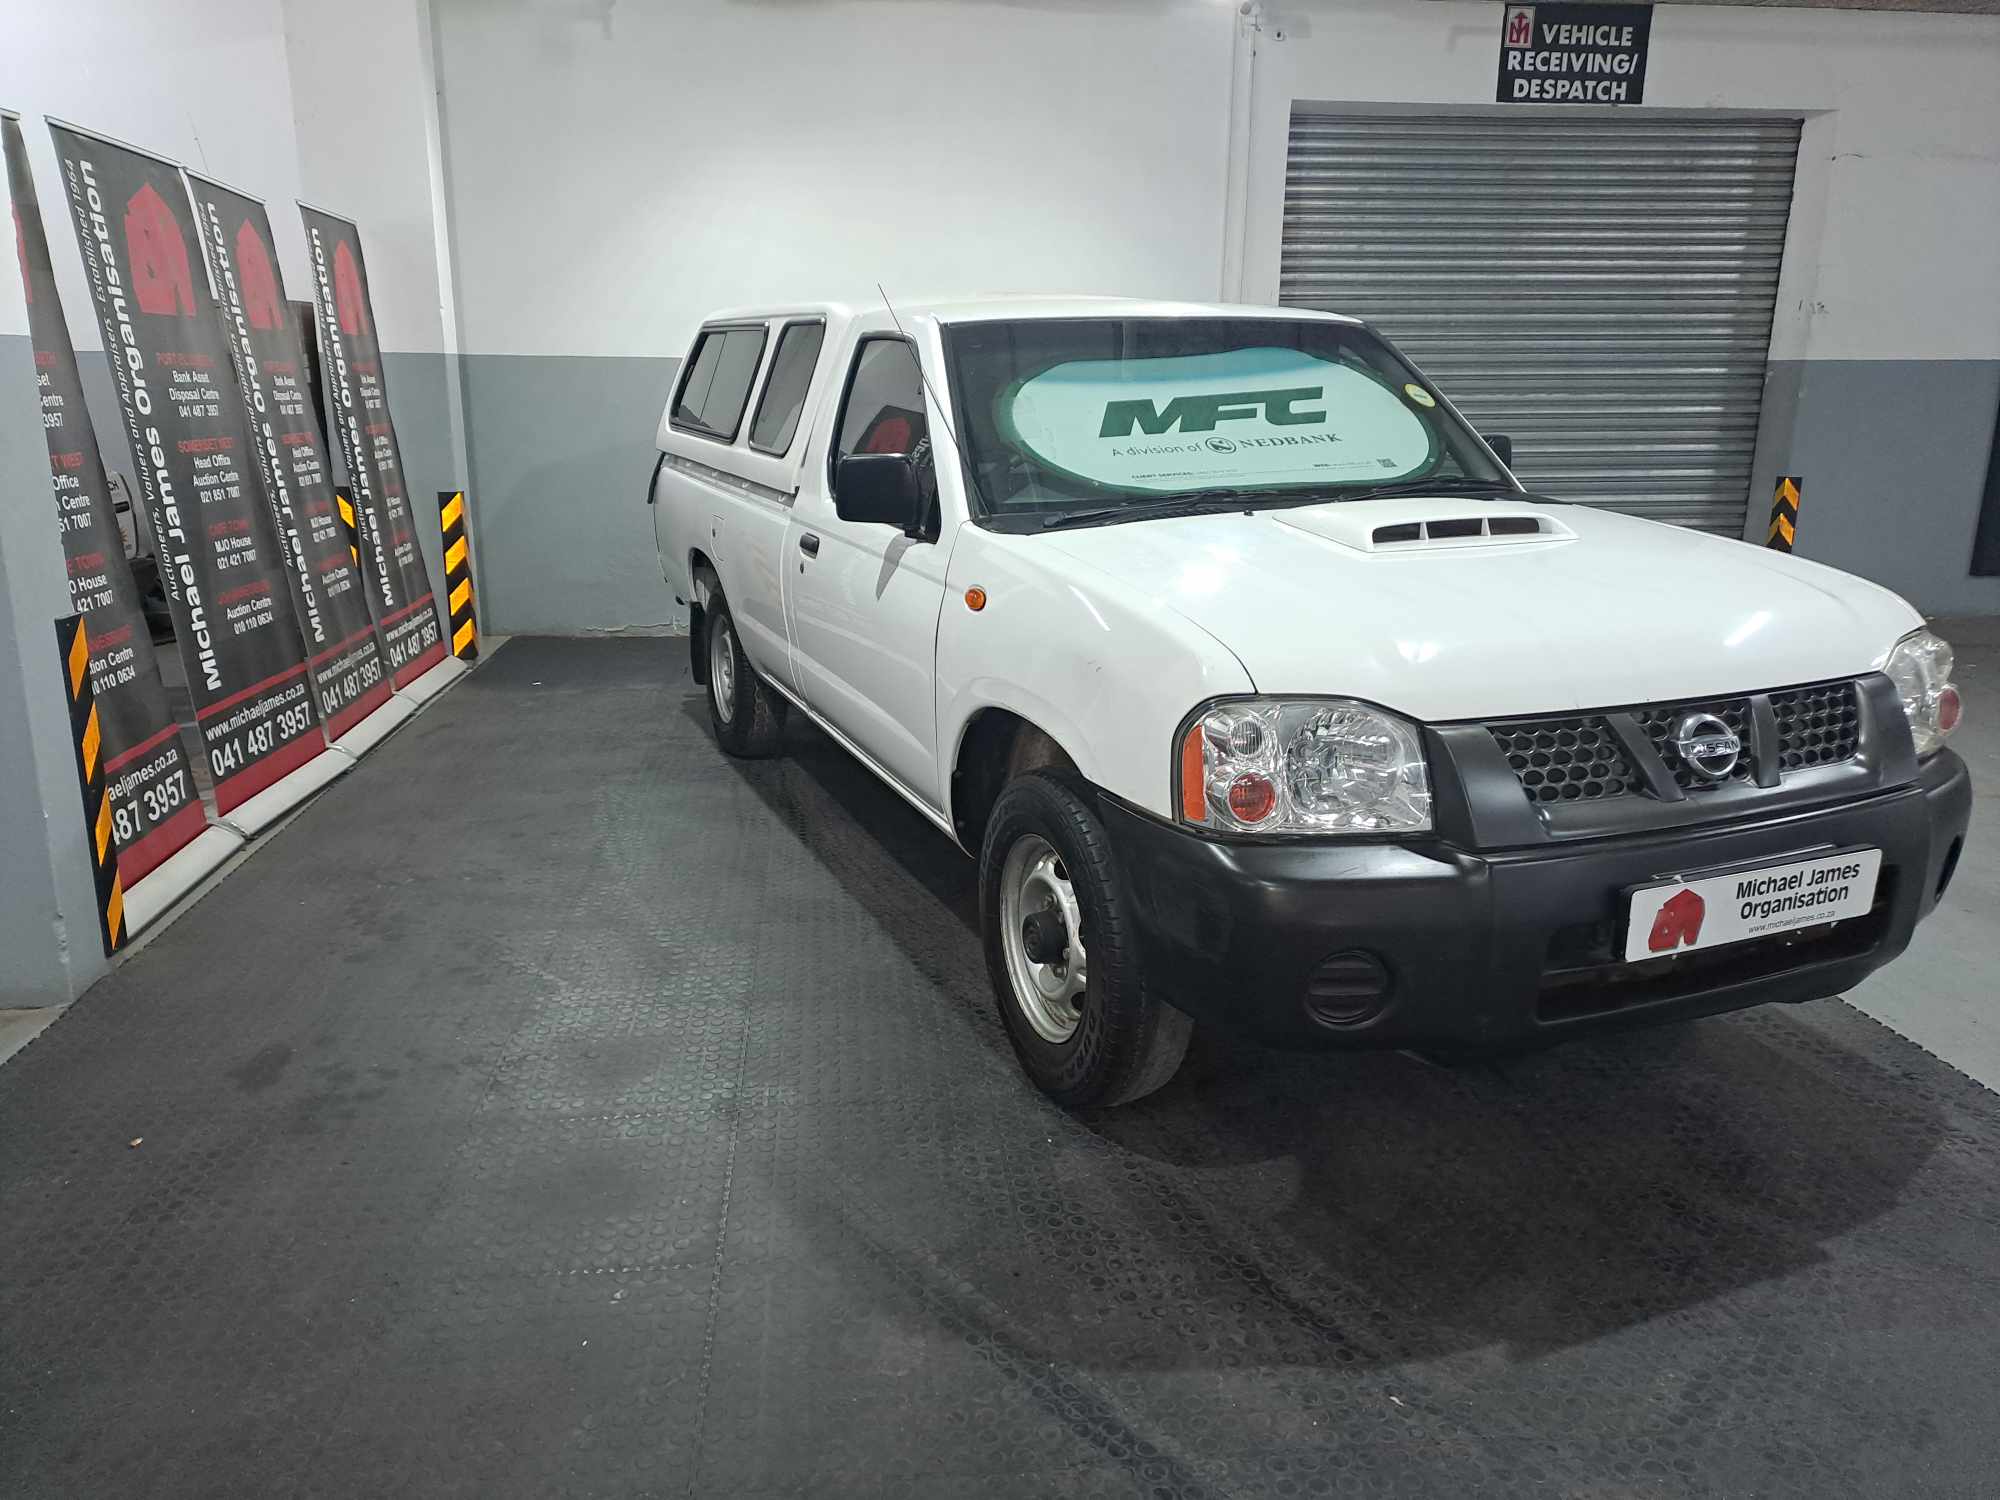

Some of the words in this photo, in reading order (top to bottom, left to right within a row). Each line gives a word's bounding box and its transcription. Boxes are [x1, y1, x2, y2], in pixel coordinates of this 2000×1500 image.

[1542, 24, 1633, 46] VEHICLE
[1507, 51, 1639, 75] RECEIVING/
[1513, 78, 1627, 101] DESPATCH
[64, 158, 82, 201] 1964
[74, 204, 106, 303] Established
[79, 159, 152, 416] Organisation
[207, 202, 265, 413] Organisation
[311, 228, 352, 408] Organisation
[104, 318, 132, 402] Appraisers
[172, 370, 191, 383] Bank
[40, 393, 64, 407] entre
[168, 387, 200, 402] Disposal
[42, 412, 63, 428] 3957
[125, 407, 139, 439] and
[178, 405, 192, 417] 041
[192, 404, 205, 417] 487
[247, 406, 259, 433] and
[334, 401, 345, 425] and
[1099, 386, 1327, 438] MFC
[347, 415, 372, 500] James
[1112, 447, 1124, 456] A
[1127, 443, 1184, 456] division
[1187, 442, 1202, 453] of
[1240, 433, 1342, 449] NEDBANK
[135, 443, 155, 501] Valuers
[193, 456, 211, 469] Head
[255, 436, 271, 484] Valuers
[262, 422, 294, 520] James
[52, 474, 80, 491] Office
[145, 427, 186, 544] James
[193, 473, 219, 487] Auction
[61, 494, 91, 511] Centre
[200, 490, 212, 503] 021
[212, 488, 225, 501] 851
[70, 512, 92, 530] 7007
[152, 507, 181, 600] Auctioneers,
[214, 538, 230, 553] MJO
[230, 536, 252, 549] House
[365, 507, 394, 606] Michael
[217, 556, 229, 570] 021
[229, 553, 241, 567] 421
[68, 579, 77, 594] O
[77, 574, 107, 591] House
[286, 528, 325, 643] Michael
[77, 596, 94, 612] 421
[94, 589, 113, 608] 7007
[226, 605, 251, 620] Auction
[250, 597, 273, 612] Centre
[174, 553, 222, 691] Michael
[233, 621, 246, 635] 010
[246, 616, 258, 631] 110
[257, 610, 273, 626] 0634
[107, 647, 134, 666] Centre
[389, 642, 407, 668] 041
[407, 633, 420, 656] 487
[420, 621, 438, 648] 3957
[100, 673, 117, 691] 110
[116, 665, 136, 684] 0634
[321, 682, 343, 714] 041
[343, 670, 361, 699] 487
[359, 656, 382, 687] 3957
[205, 683, 305, 742] www.michaeljames.co.za
[211, 737, 244, 777] 041
[247, 720, 274, 756] 487
[276, 700, 311, 740] 3957
[107, 748, 178, 801] aeljames.co.za
[143, 769, 186, 821] 3957
[1736, 870, 1803, 900] Michael
[1806, 863, 1860, 887] James
[1740, 885, 1849, 919] Organisation
[1748, 910, 1836, 934] www.michaeljames.co.za
